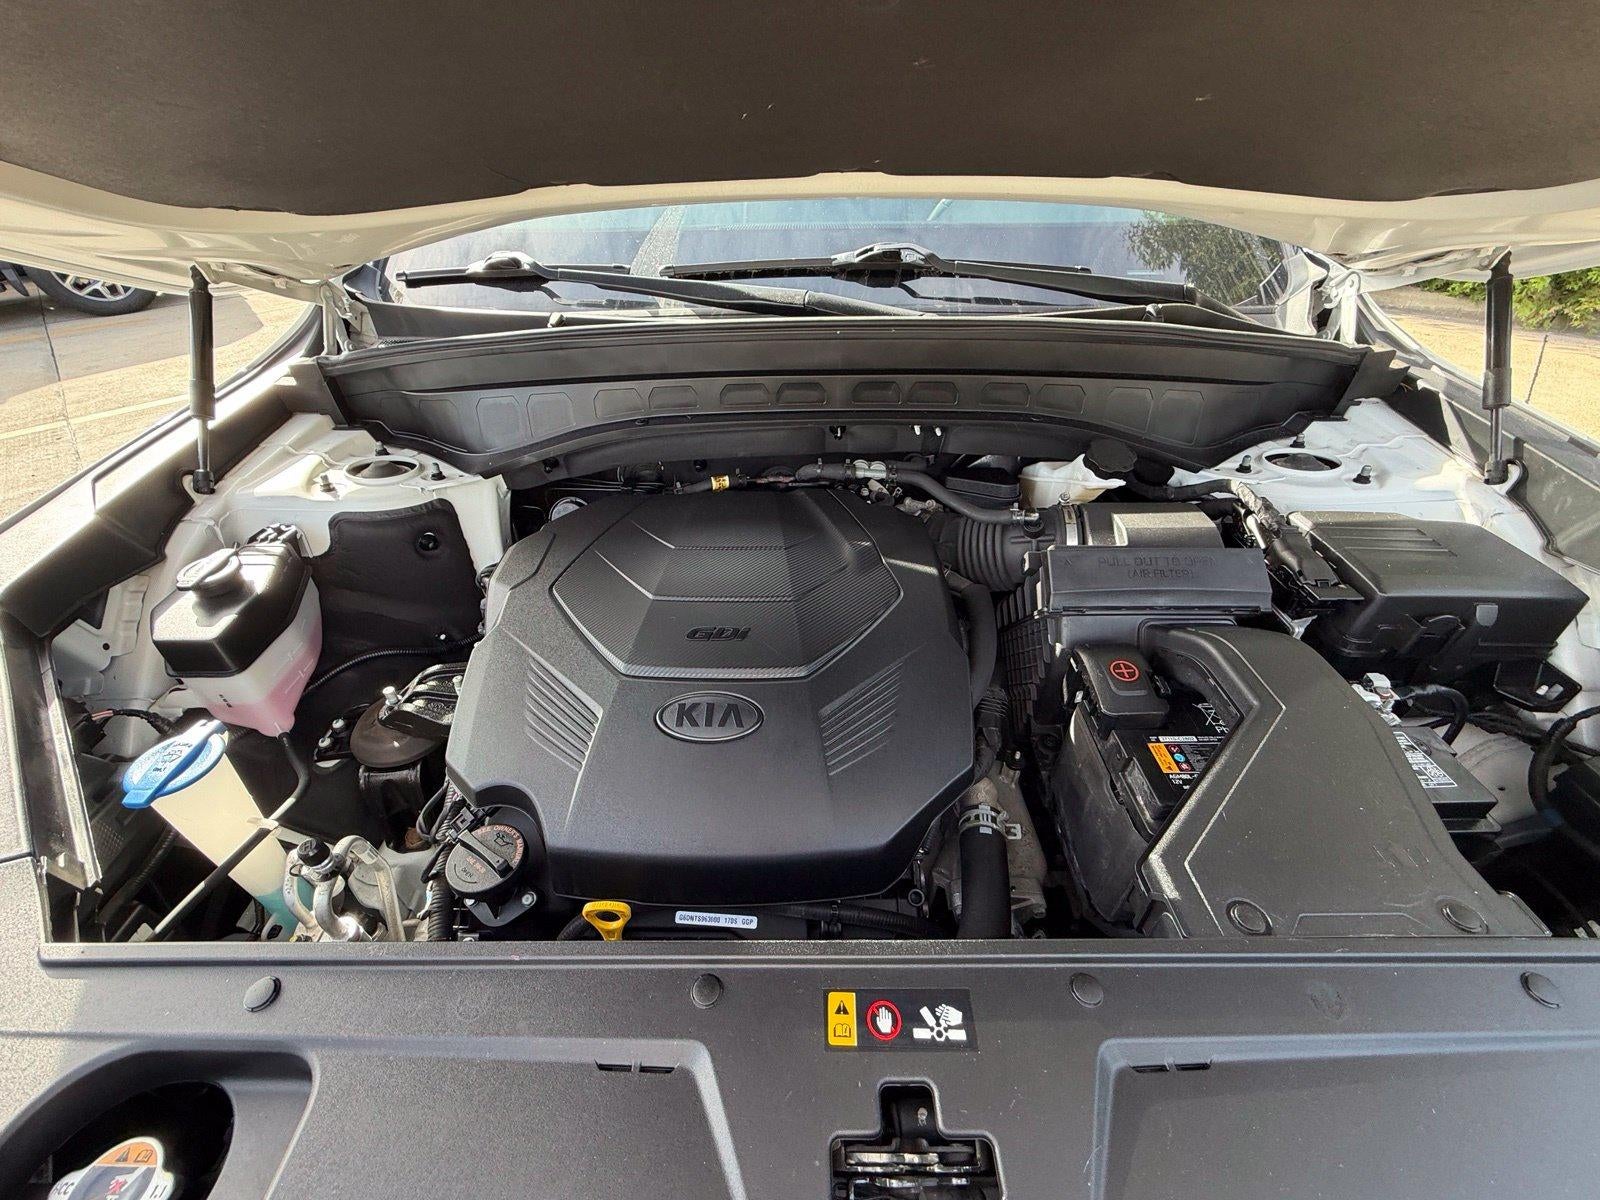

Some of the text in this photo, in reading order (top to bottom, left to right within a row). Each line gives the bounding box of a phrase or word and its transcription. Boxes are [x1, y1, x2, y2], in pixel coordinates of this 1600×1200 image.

[1098, 556, 1130, 567] PULL
[1134, 556, 1161, 567] OUT
[675, 702, 744, 729] KIA
